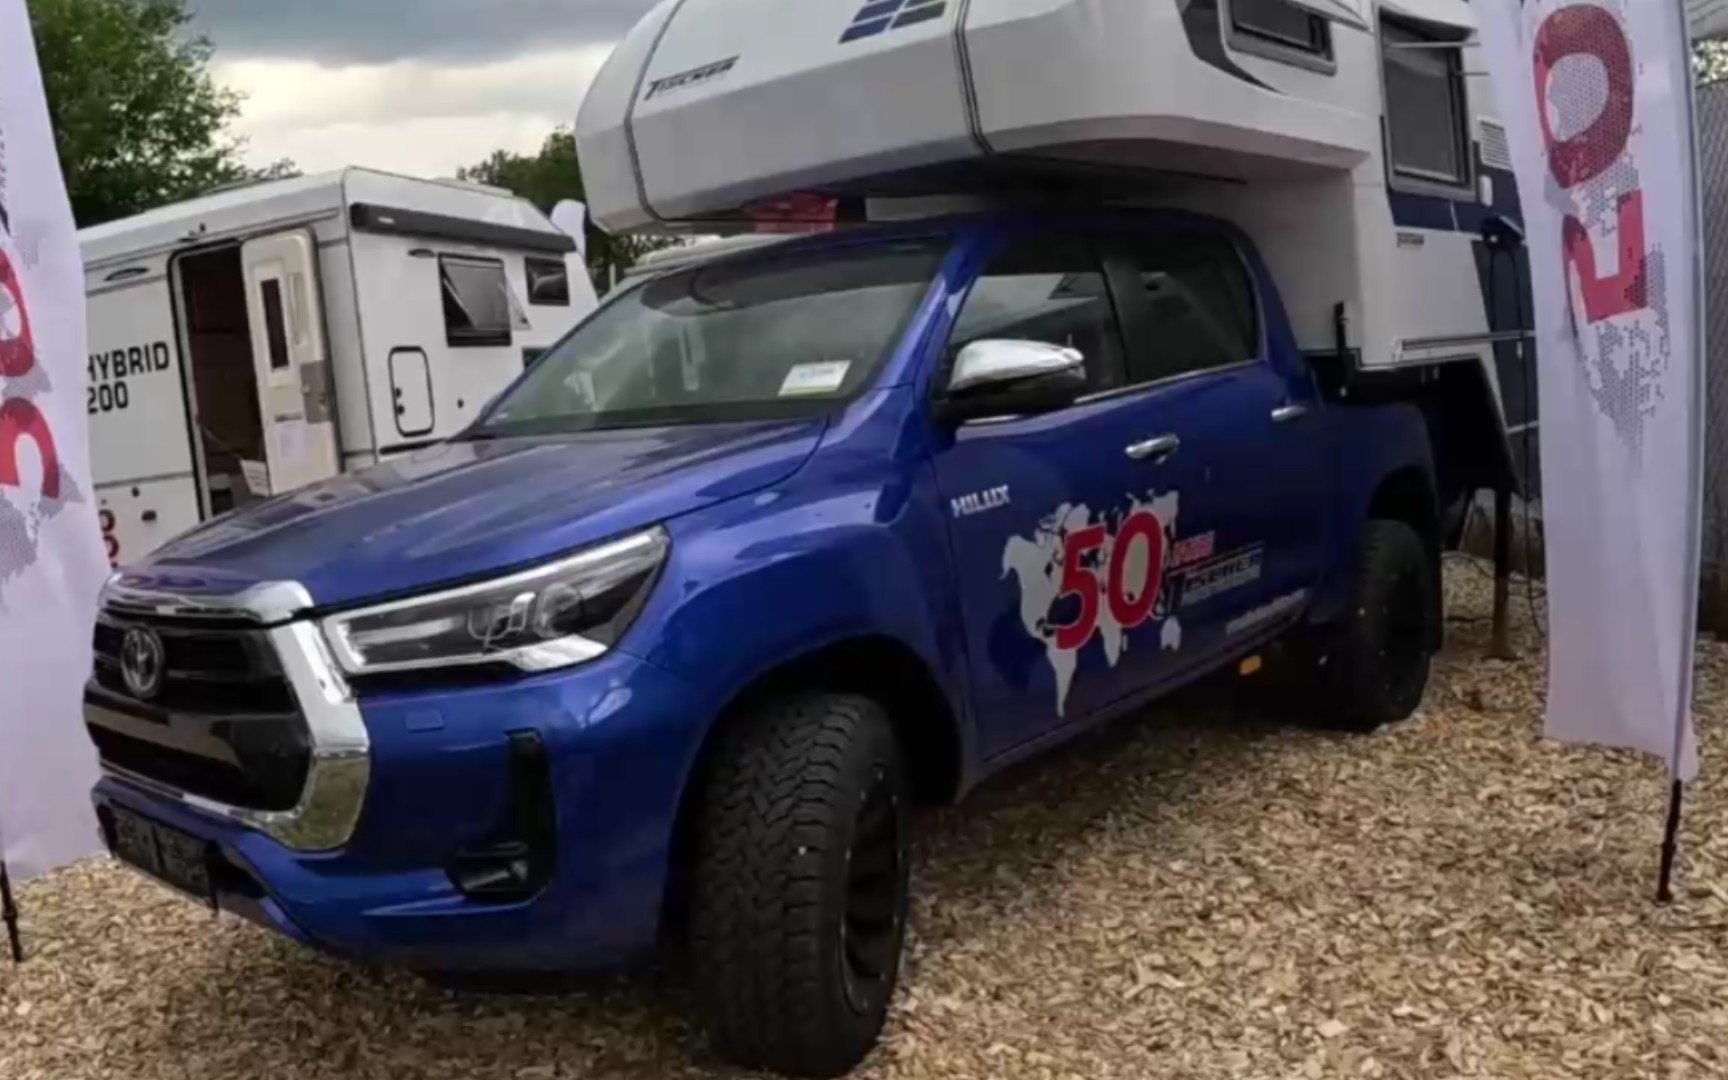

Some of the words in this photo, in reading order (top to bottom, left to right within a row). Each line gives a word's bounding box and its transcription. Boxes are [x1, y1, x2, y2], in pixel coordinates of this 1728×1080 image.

[87, 381, 128, 415] 200
[951, 484, 1010, 518] HILUX
[1055, 510, 1163, 651] 50
